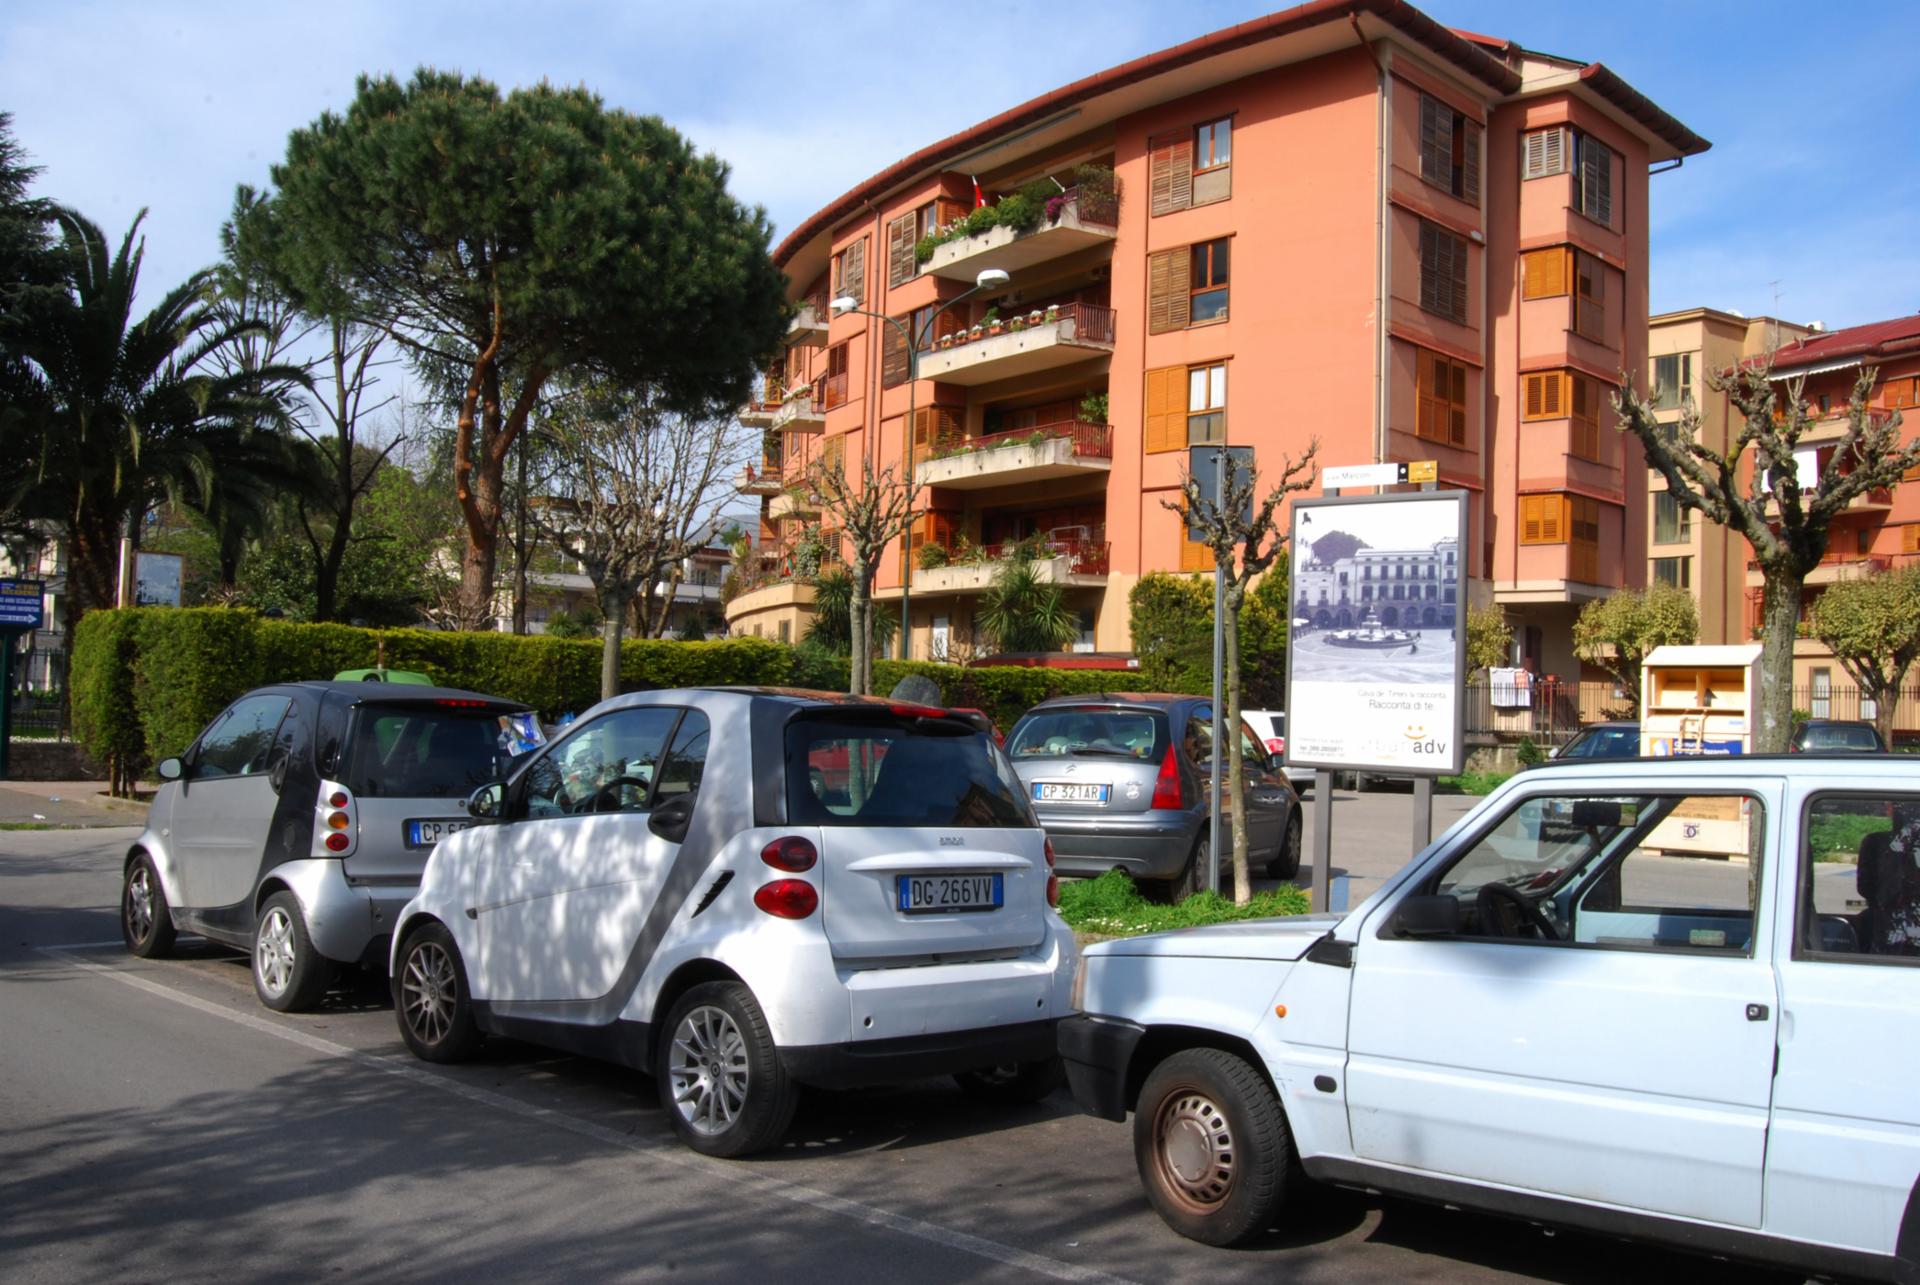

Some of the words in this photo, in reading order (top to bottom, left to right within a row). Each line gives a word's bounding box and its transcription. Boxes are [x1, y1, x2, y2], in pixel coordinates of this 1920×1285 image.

[1368, 698, 1411, 710] Racconta
[1042, 785, 1057, 799] CP
[1061, 786, 1099, 799] 321AR
[422, 823, 442, 841] CP
[912, 880, 934, 905] DG
[940, 877, 991, 905] 266VV
